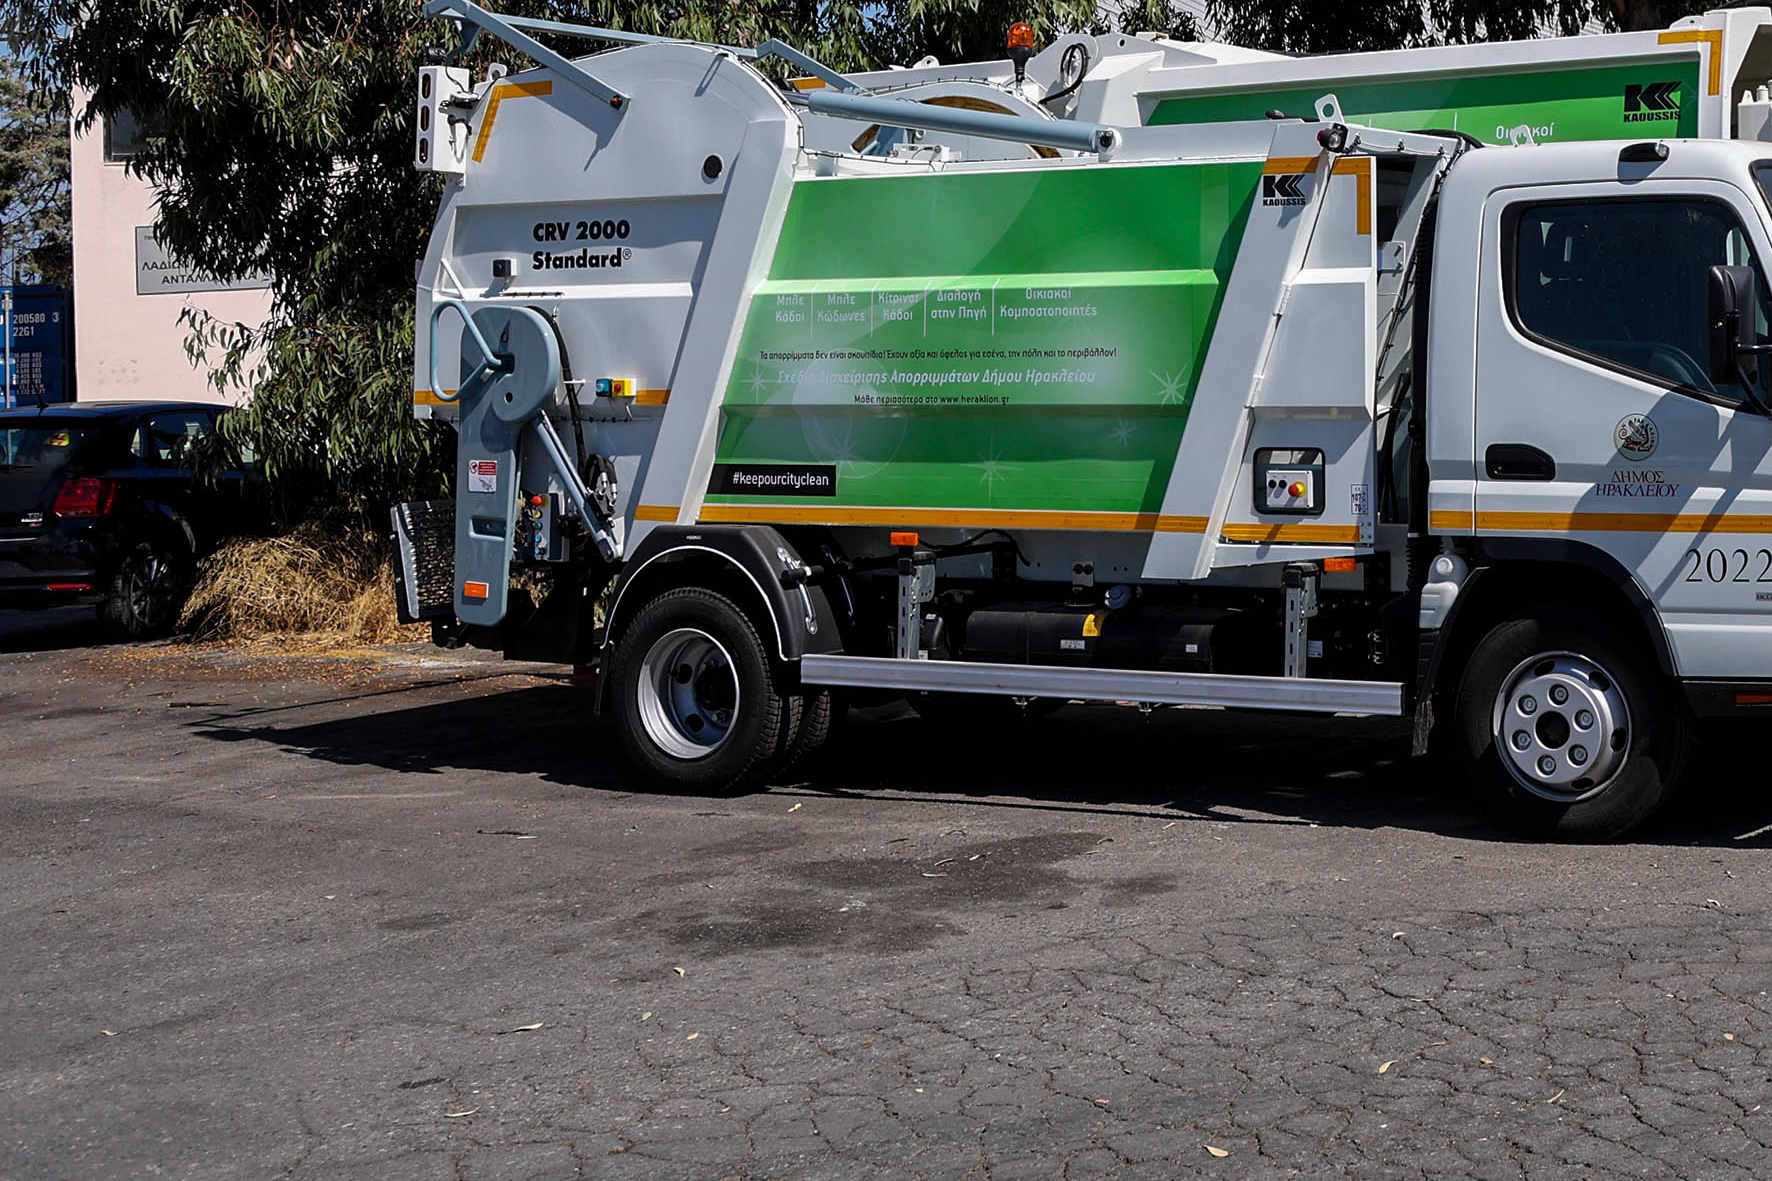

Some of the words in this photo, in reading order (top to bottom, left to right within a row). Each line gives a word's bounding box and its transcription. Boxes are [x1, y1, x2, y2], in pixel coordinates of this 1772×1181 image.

[1623, 110, 1681, 123] KAOUSSIS
[1263, 198, 1306, 206] KAOUSSIS
[533, 222, 570, 242] CRV
[575, 219, 630, 240] 2000
[776, 294, 805, 306] Μπλε
[827, 294, 856, 306] Μπλε
[878, 292, 919, 306] Κίτρινοι
[936, 290, 981, 303] Διαλογή
[1025, 287, 1072, 300] Οικιακοί
[13, 313, 46, 324] 200580
[52, 312, 60, 323] 3
[775, 310, 805, 323] Κάδοι
[817, 310, 865, 323] Κώδωνες
[883, 309, 913, 321] Κάδοι
[931, 309, 955, 319] στην
[958, 306, 987, 320] Πηγή
[1000, 304, 1097, 319] Κομποστοποιητές
[760, 351, 768, 360] Τα
[769, 350, 814, 362] απορρίμματα
[815, 351, 828, 360] δεν
[829, 351, 847, 360] είναι
[848, 350, 885, 361] σκουπίδια!
[910, 350, 925, 361] αξία
[927, 351, 938, 359] και
[940, 349, 967, 360] όφελος
[968, 350, 981, 360] για
[982, 349, 1007, 359] εσένα,
[1008, 350, 1021, 359] την
[1022, 349, 1042, 359] πόλη
[1044, 350, 1056, 358] και
[1057, 350, 1066, 358] το
[1067, 348, 1116, 360] περιβάλλον!
[890, 369, 979, 386] Απορριμμάτων
[982, 369, 1022, 385] Δήμου
[1025, 369, 1096, 386] Ηρακλείου
[854, 394, 874, 404] Μάθε
[875, 394, 924, 406] περισσότερα
[925, 396, 938, 404] στο
[940, 394, 1010, 406] www.heraklion.gr
[733, 471, 829, 489] #keepourcityclean
[1611, 470, 1665, 483] ΔΗΜΟΣ
[1596, 483, 1680, 497] ΗΡΑΚΛΕΙΟΥ
